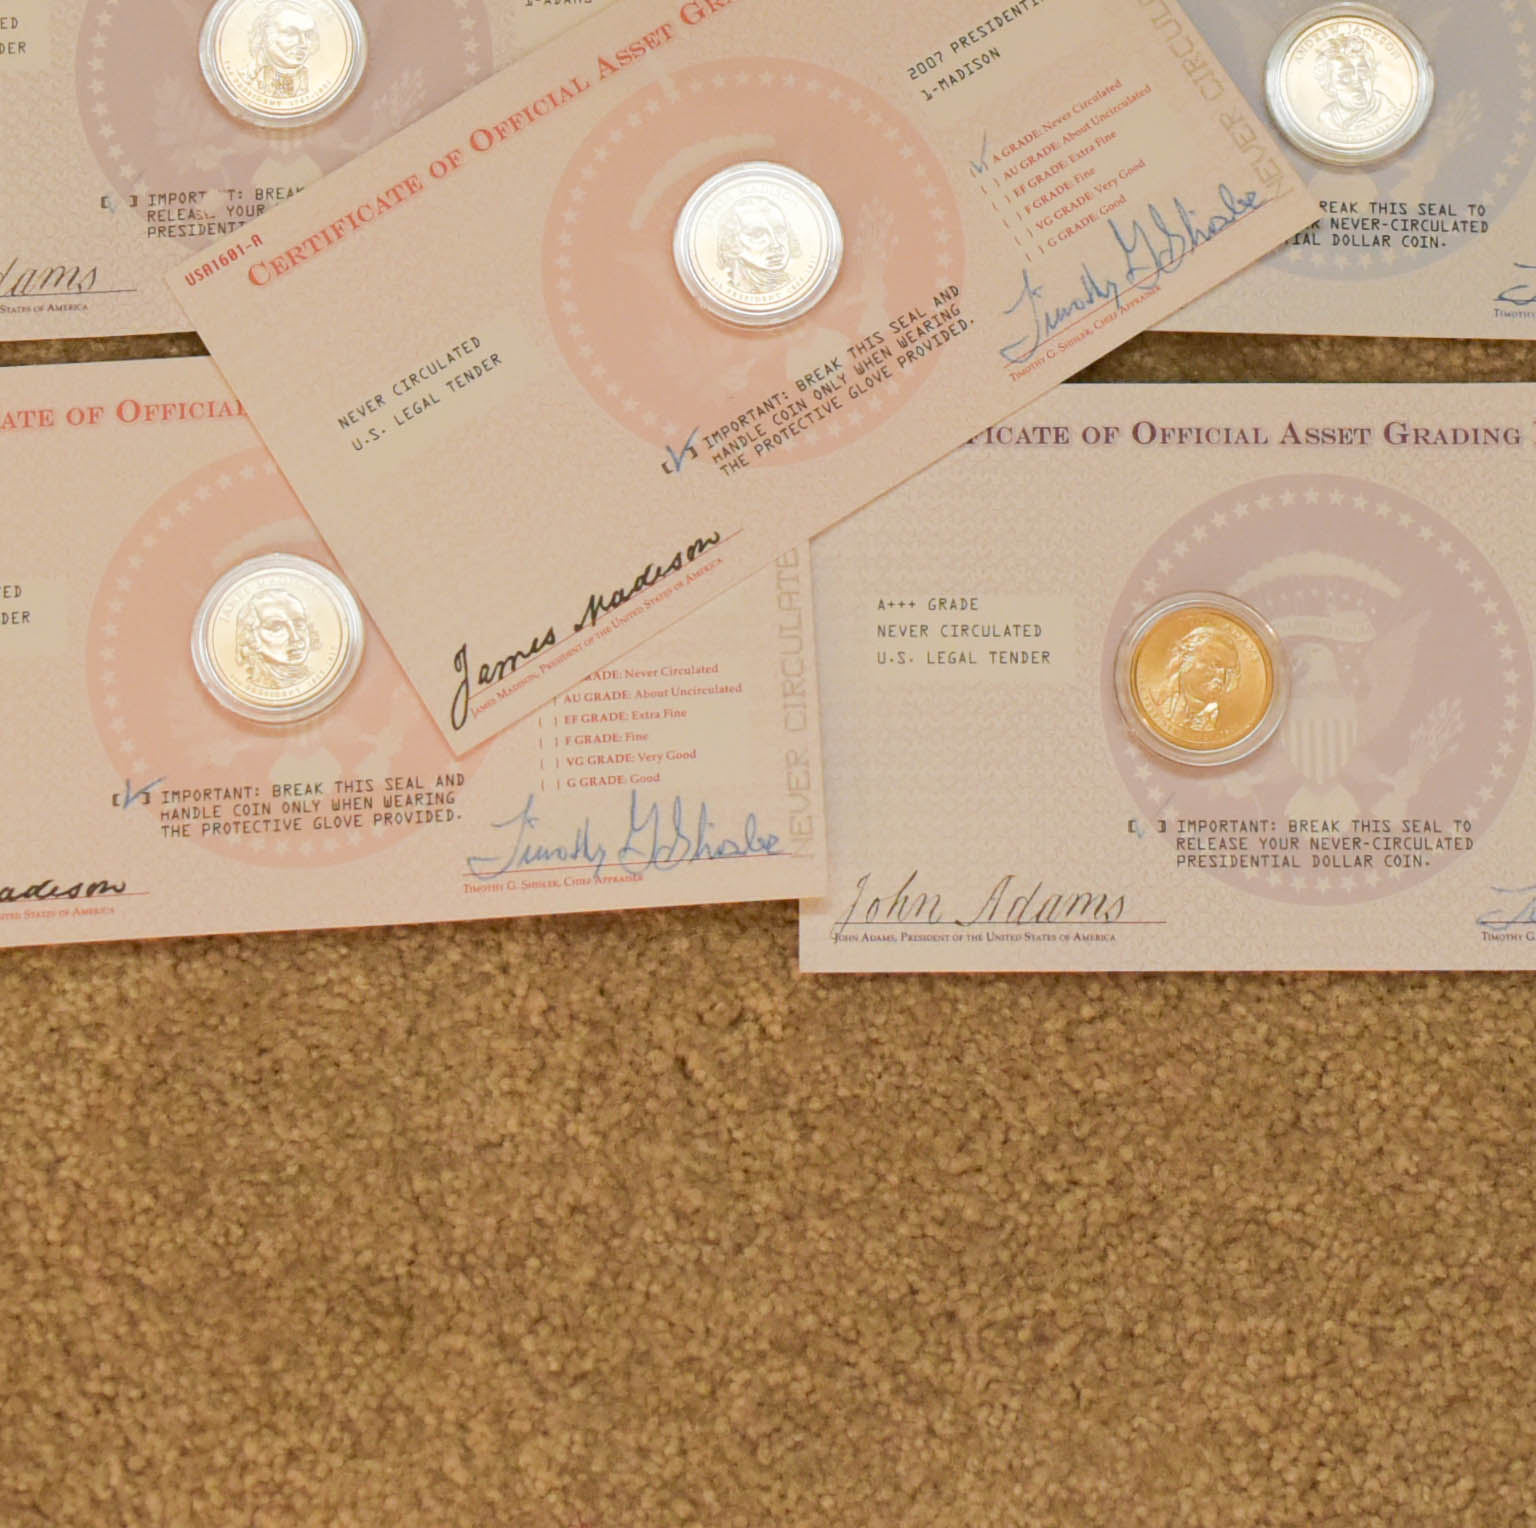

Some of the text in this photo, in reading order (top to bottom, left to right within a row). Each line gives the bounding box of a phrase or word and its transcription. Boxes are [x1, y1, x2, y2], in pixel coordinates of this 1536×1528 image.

[906, 50, 944, 81] 2007
[920, 47, 1001, 102] 1-MADISON
[247, 173, 425, 287] CERTIFICATE
[427, 147, 463, 180] OF
[468, 76, 591, 153] OFFICIAL
[597, 22, 674, 82] ASSET
[337, 335, 481, 430] NEVER CIRCULATED
[351, 352, 503, 451] U.S. LEGAL TENDER
[65, 406, 105, 427] OF
[1081, 426, 1120, 445] OF
[1131, 420, 1269, 446] OFFICIAL
[1278, 421, 1372, 446] ASSET
[1383, 420, 1521, 446] GRADING
[877, 623, 1042, 639] NEVER CIRCULATED
[1176, 818, 1472, 834] IMPORTANT: BREAK THIS SEAL TO
[1176, 836, 1474, 852] RELEASE YOUR NEVER-CIRCULATED
[1176, 853, 1431, 869] PRESIDENTIAL DOLLAR COIN.
[831, 870, 1126, 938] John Adams
